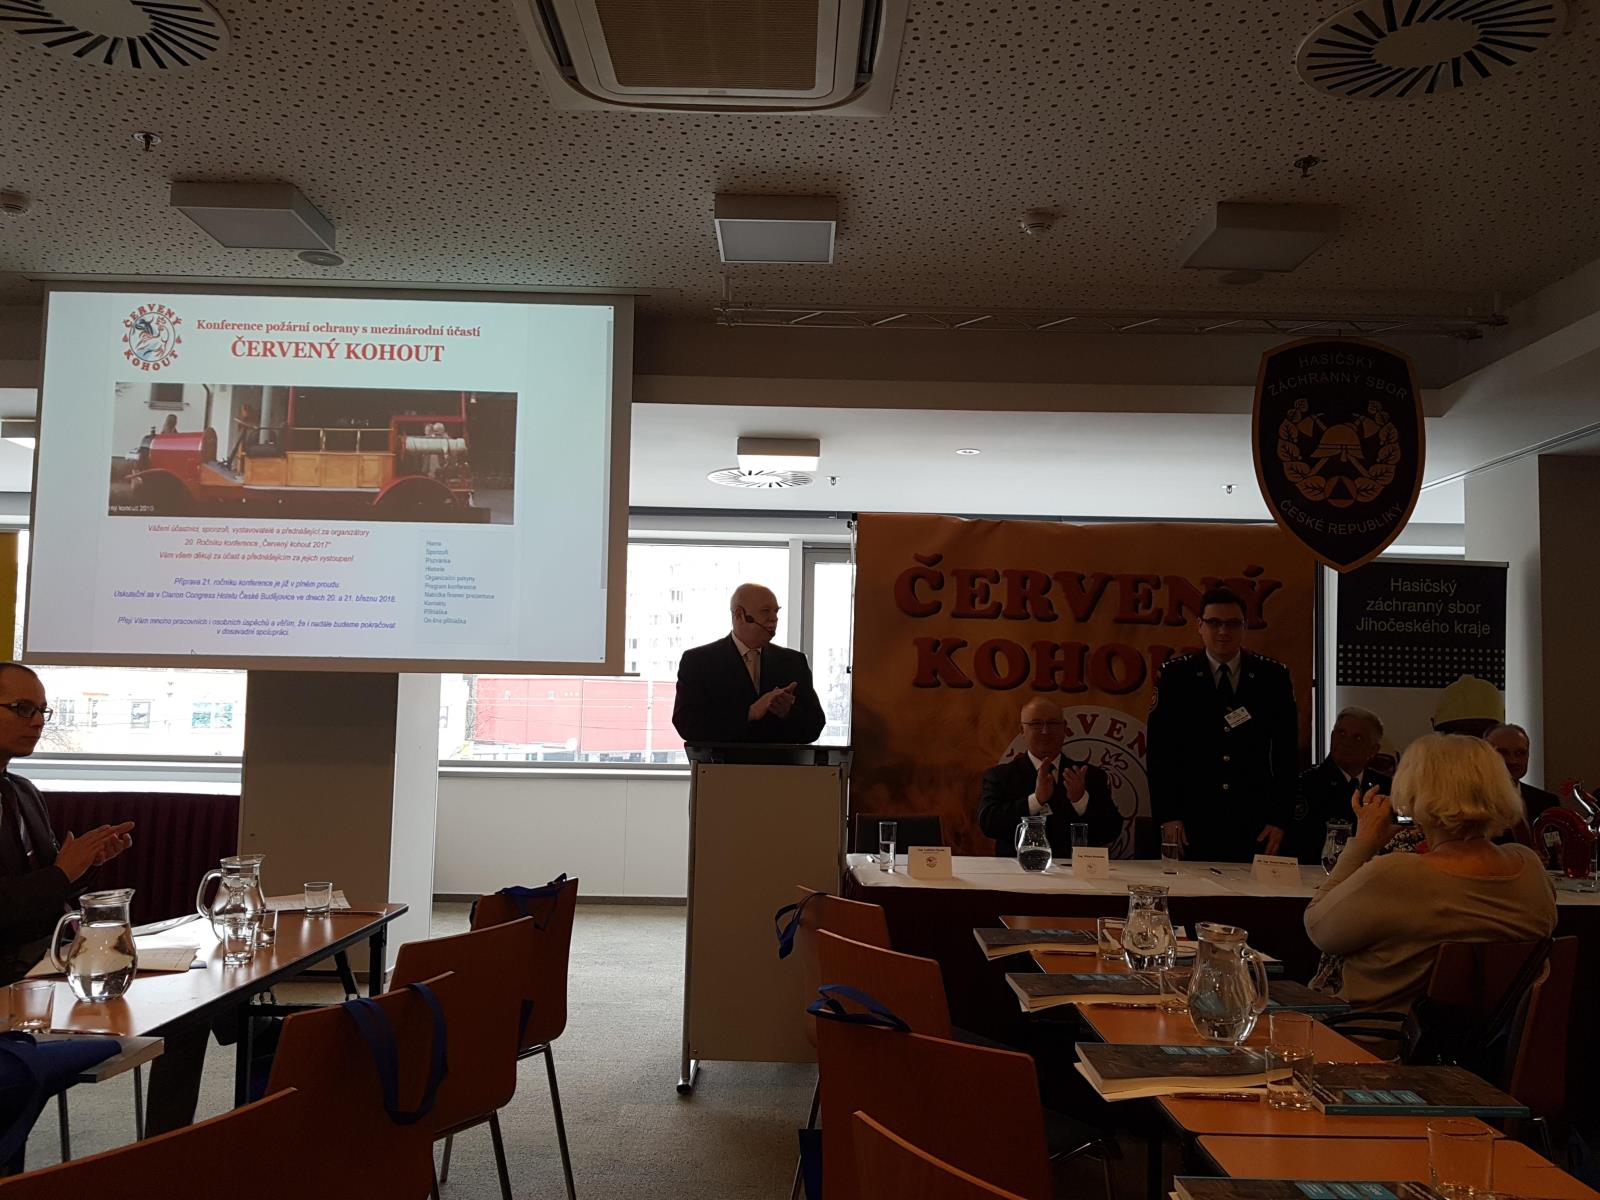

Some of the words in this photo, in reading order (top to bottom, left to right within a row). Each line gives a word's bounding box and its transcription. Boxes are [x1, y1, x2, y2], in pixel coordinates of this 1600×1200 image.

[196, 319, 263, 331] Konference
[266, 320, 310, 334] požární
[312, 322, 360, 336] ochrany
[362, 326, 368, 334] s
[370, 324, 444, 336] mezinárodní
[446, 325, 481, 337] účastí
[231, 336, 340, 360] ČERVENÝ
[344, 342, 444, 362] KOHOUT
[123, 348, 179, 372] KOHOUT
[1328, 501, 1403, 535] REPUBLIKY
[331, 528, 369, 538] organizátory
[224, 540, 258, 548] konference
[290, 540, 312, 548] kohout
[238, 579, 273, 588] konference
[295, 580, 316, 589] plném
[894, 552, 1283, 630] ČERVENÝ
[1390, 578, 1458, 596] Hasičský
[186, 591, 216, 600] Congress
[1366, 598, 1444, 616] záchranný
[1448, 600, 1482, 614] sbor
[172, 618, 208, 626] pracovních
[212, 618, 241, 626] osobních
[333, 620, 360, 628] budeme
[360, 621, 396, 630] pokračovat
[1356, 617, 1450, 634] Jihočeského
[1454, 620, 1491, 638] kraje
[912, 636, 1205, 695] KOHO
